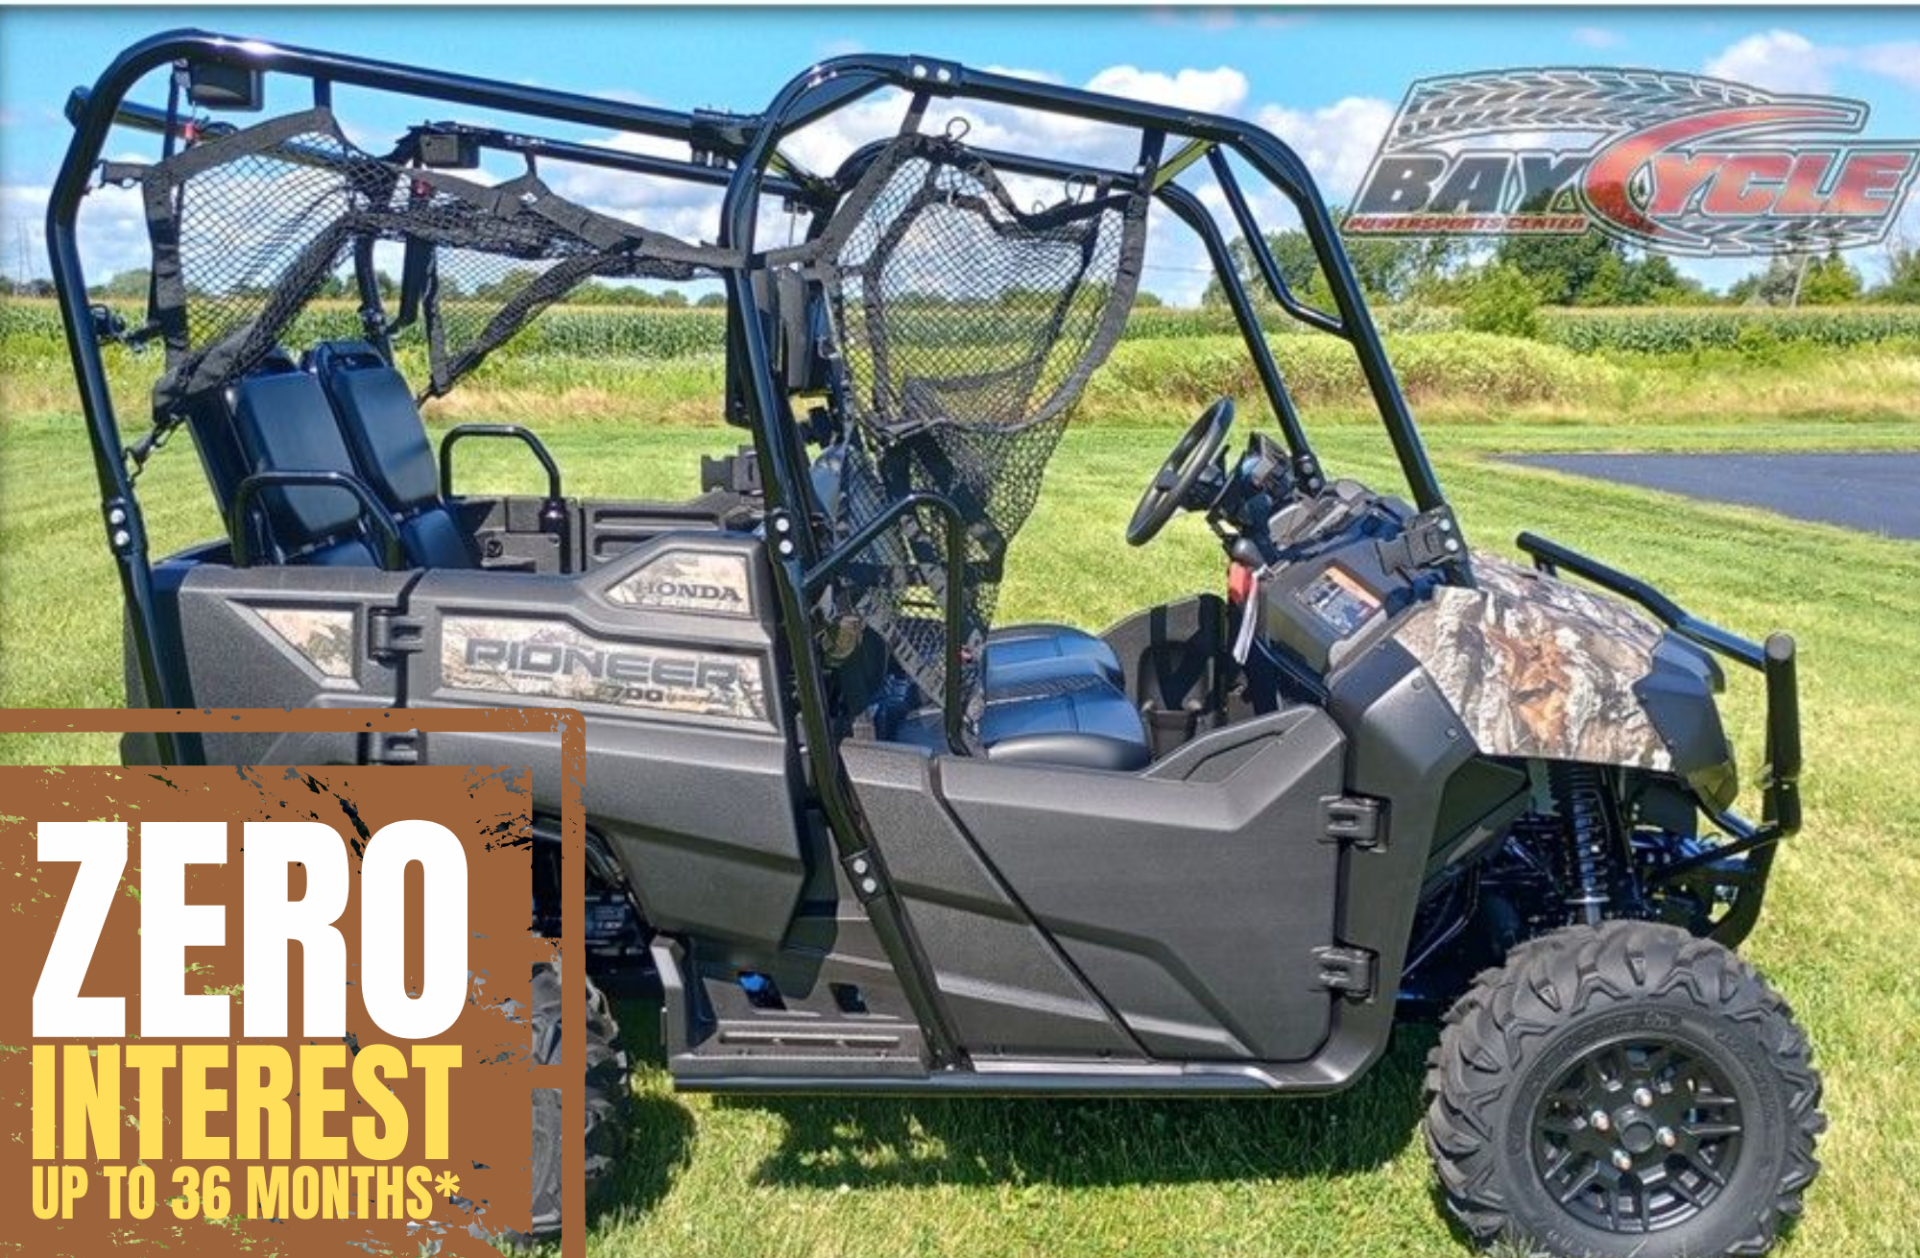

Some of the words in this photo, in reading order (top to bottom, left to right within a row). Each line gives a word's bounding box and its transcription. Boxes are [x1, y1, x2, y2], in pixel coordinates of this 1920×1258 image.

[634, 581, 744, 602] HONDA
[464, 637, 741, 691] PIONEER
[603, 684, 665, 702] 700
